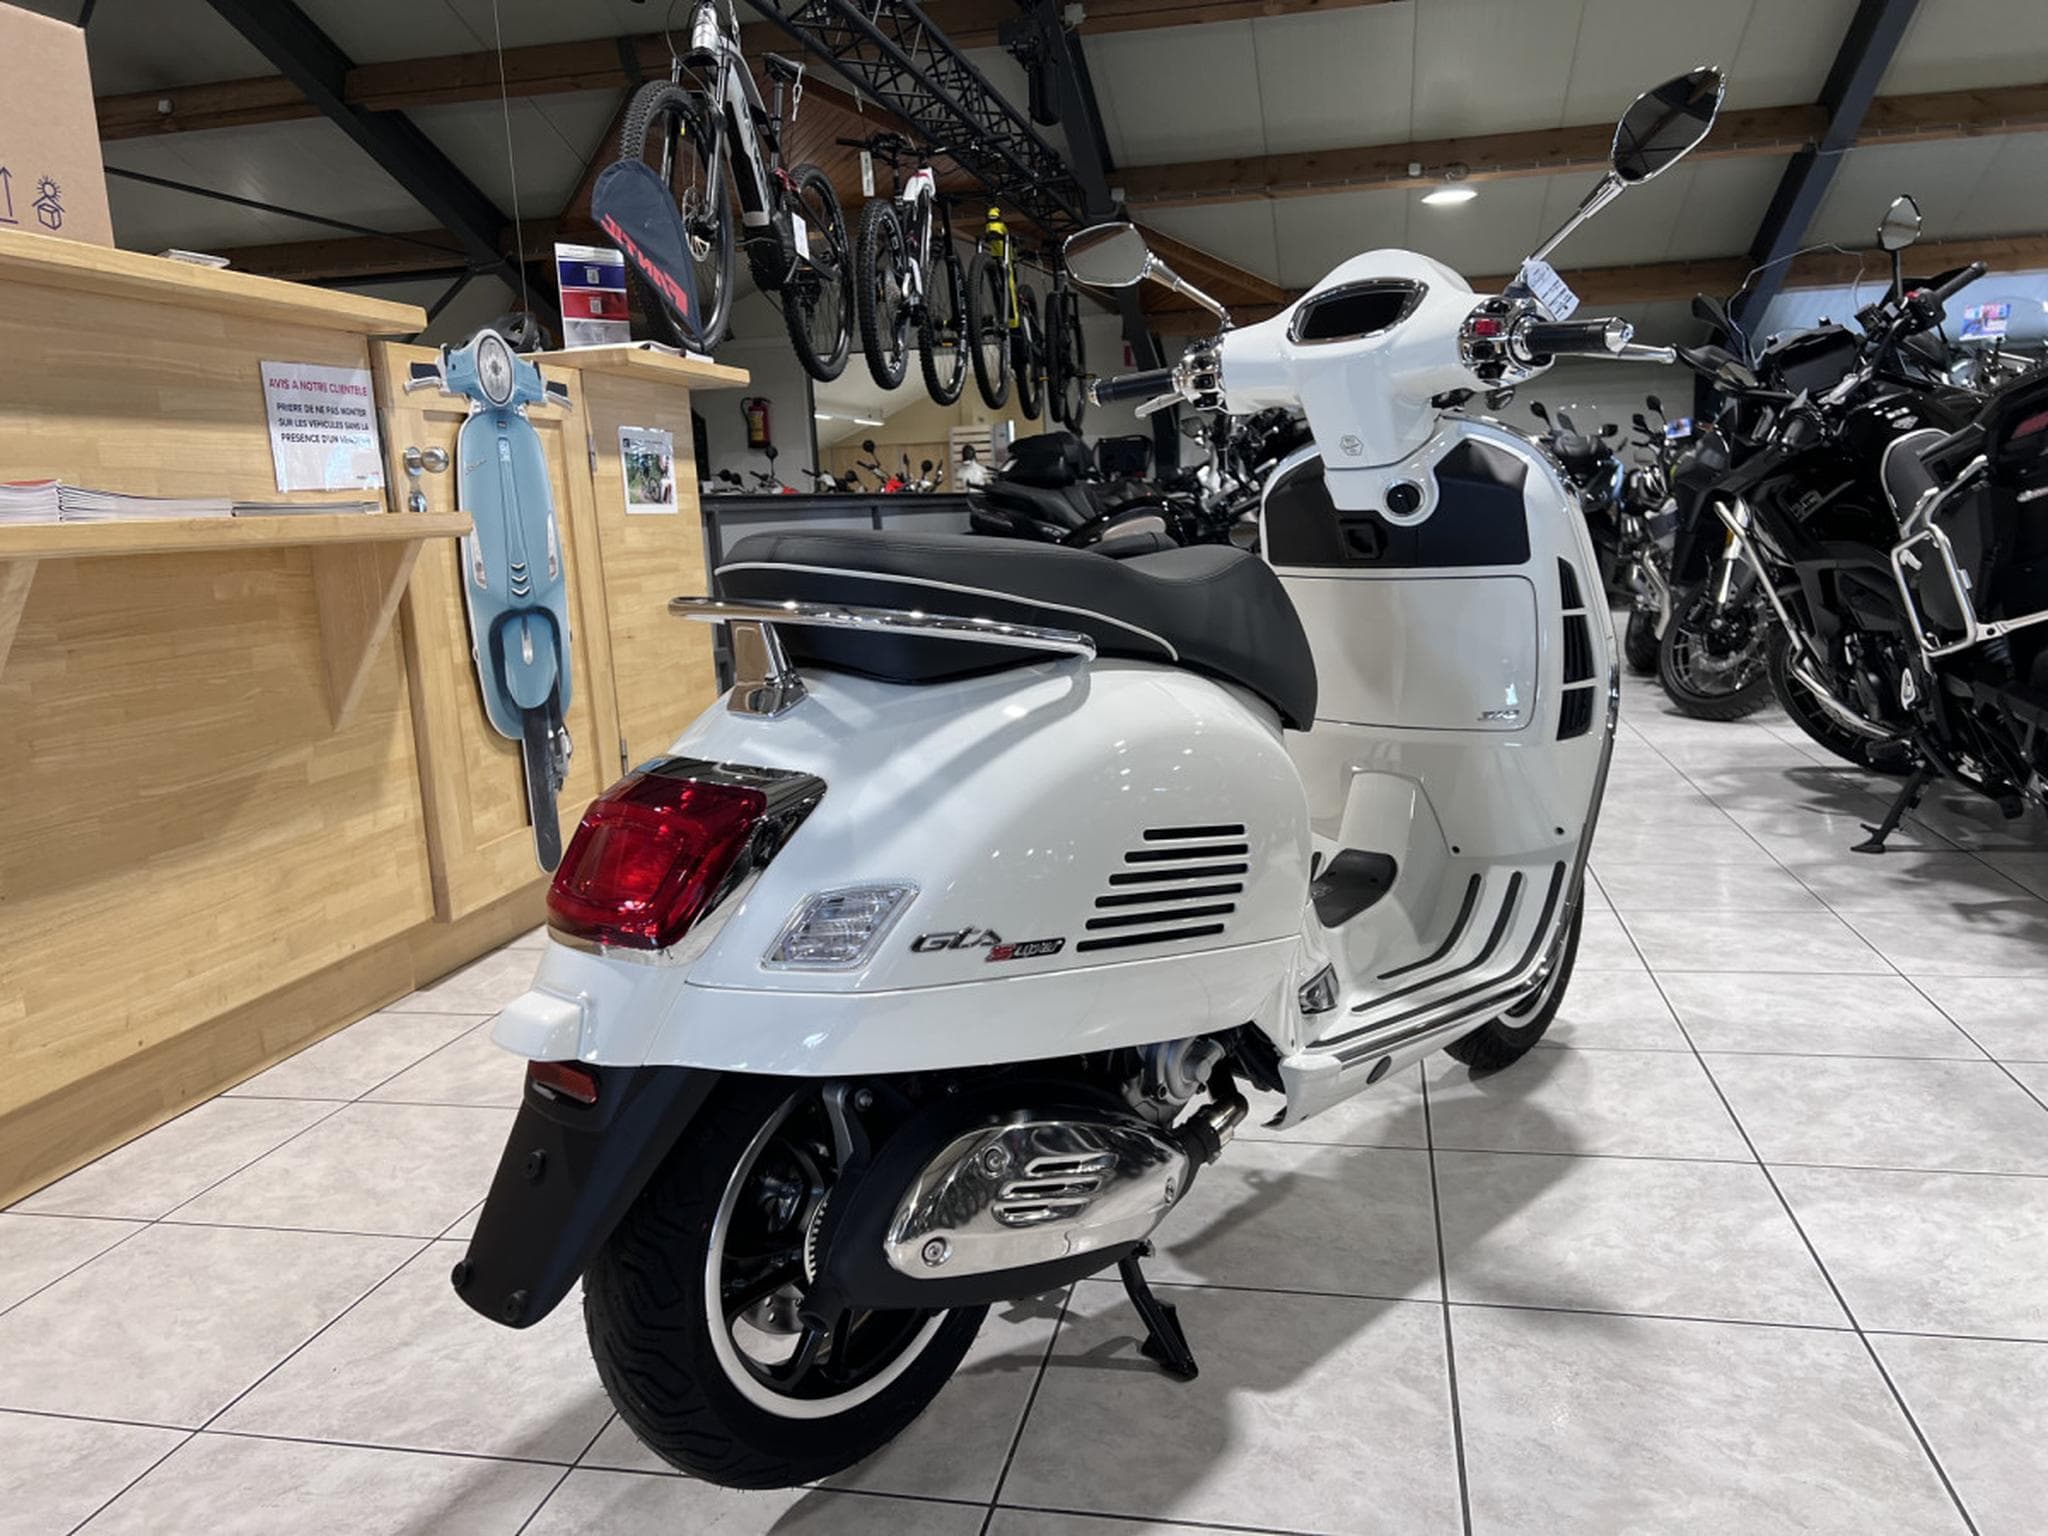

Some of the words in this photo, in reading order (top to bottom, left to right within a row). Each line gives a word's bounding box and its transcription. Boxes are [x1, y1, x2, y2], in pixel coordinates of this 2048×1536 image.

[269, 378, 290, 390] AVIS
[300, 381, 328, 393] NOTRE
[329, 383, 367, 396] CLIENTELE
[276, 402, 302, 412] PRIERE
[304, 404, 315, 414] DE
[315, 405, 325, 415] NE
[326, 406, 340, 416] PAS
[340, 407, 366, 417] MONTER
[278, 417, 293, 428] SUR
[294, 419, 308, 428] LES
[309, 419, 343, 429] VEHICULES
[344, 421, 361, 431] SANS
[361, 422, 370, 431] LA
[281, 432, 320, 442] PRESENCE
[321, 434, 339, 444] D'UN
